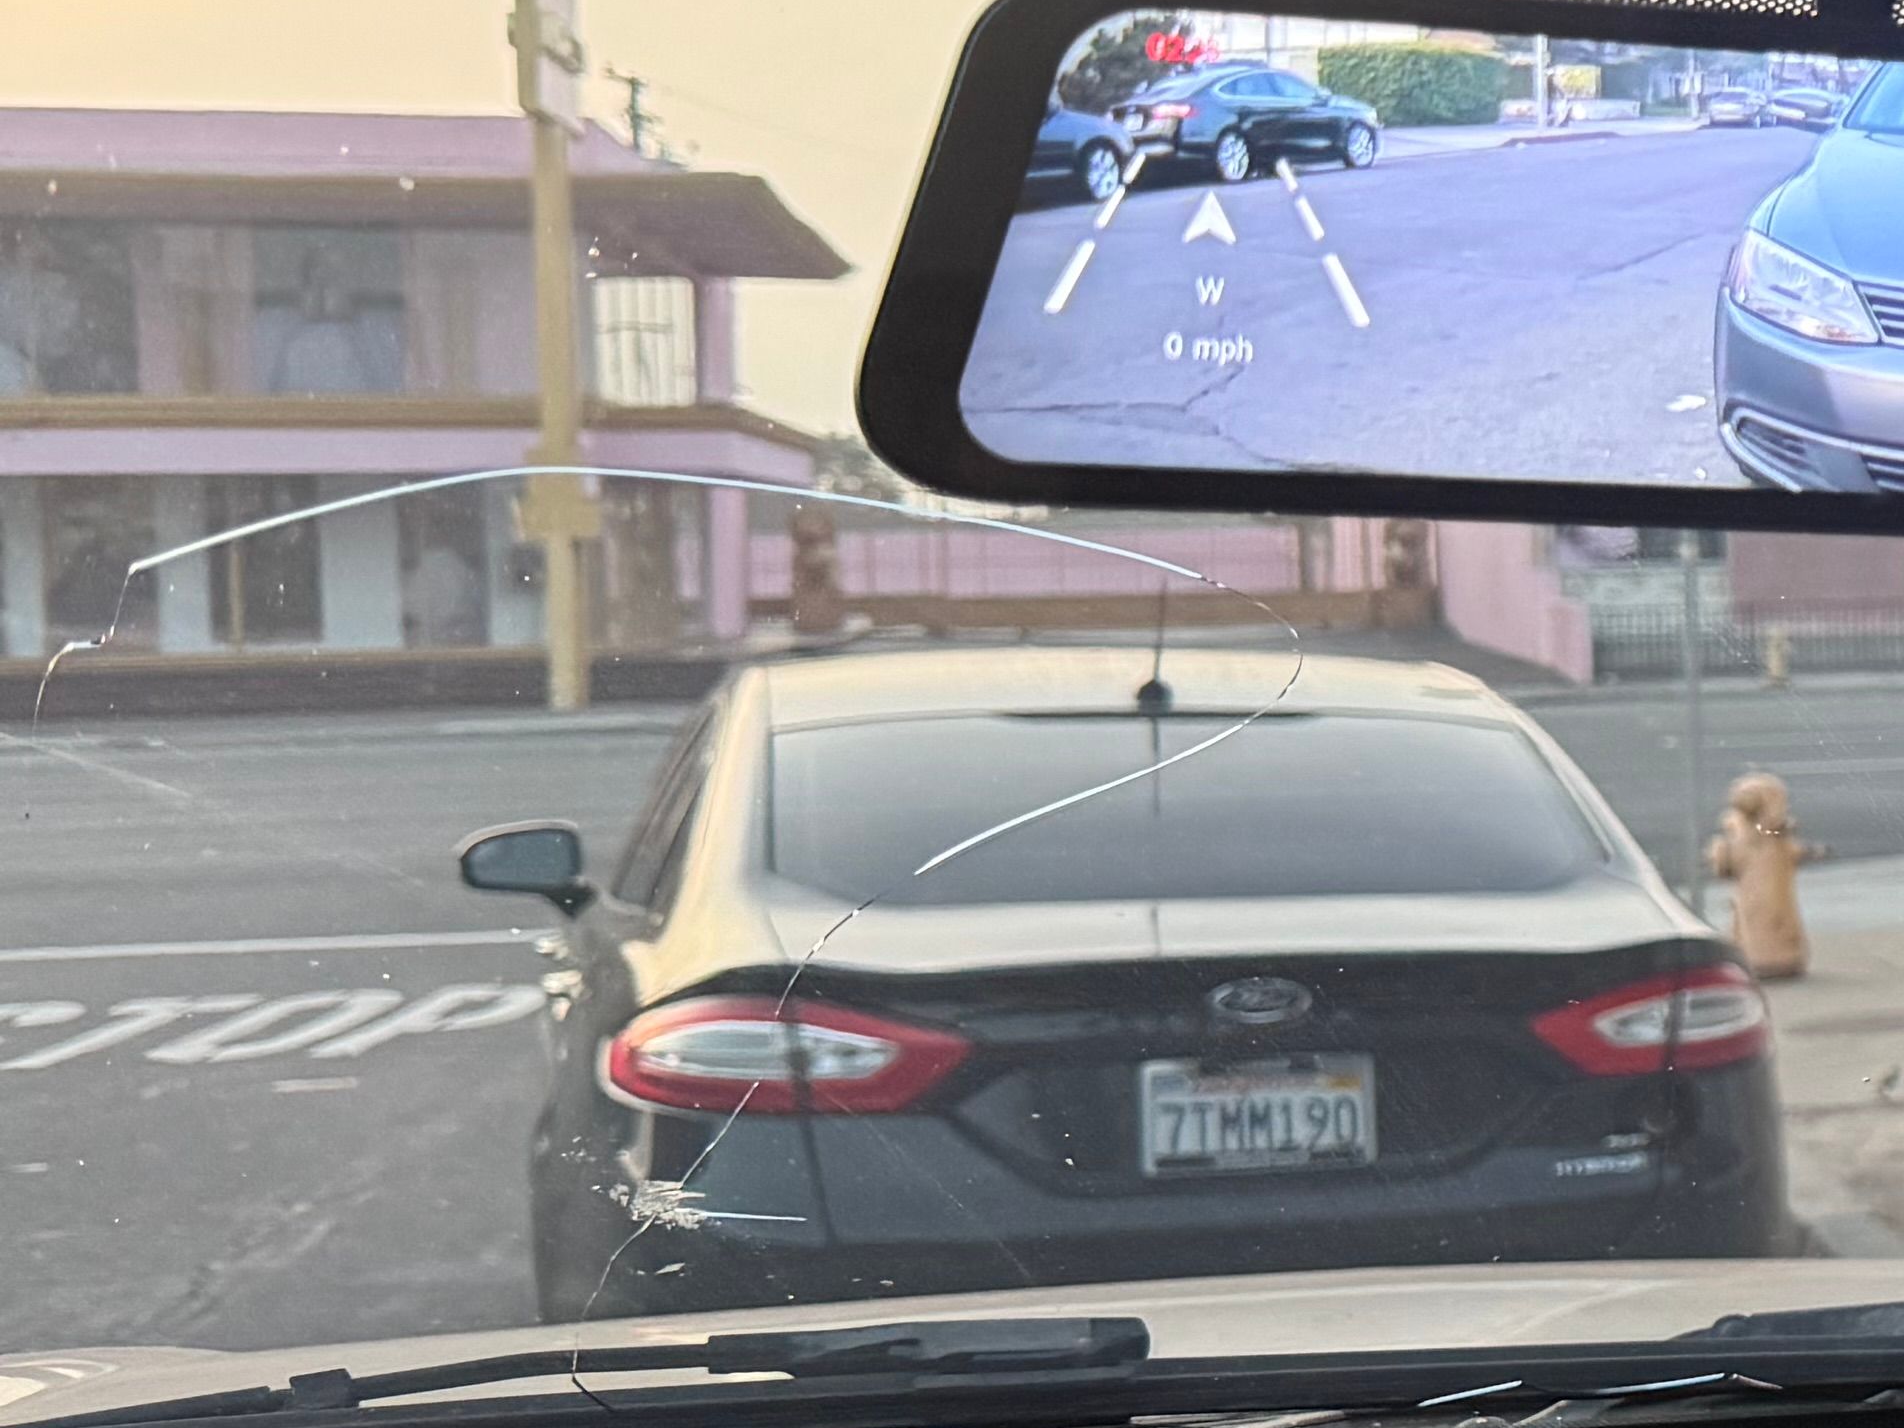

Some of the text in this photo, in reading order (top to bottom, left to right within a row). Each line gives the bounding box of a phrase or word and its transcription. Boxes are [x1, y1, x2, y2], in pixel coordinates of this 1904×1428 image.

[1195, 275, 1225, 306] W
[1163, 331, 1253, 366] 0 mph
[1157, 1094, 1359, 1154] 7TMM190
